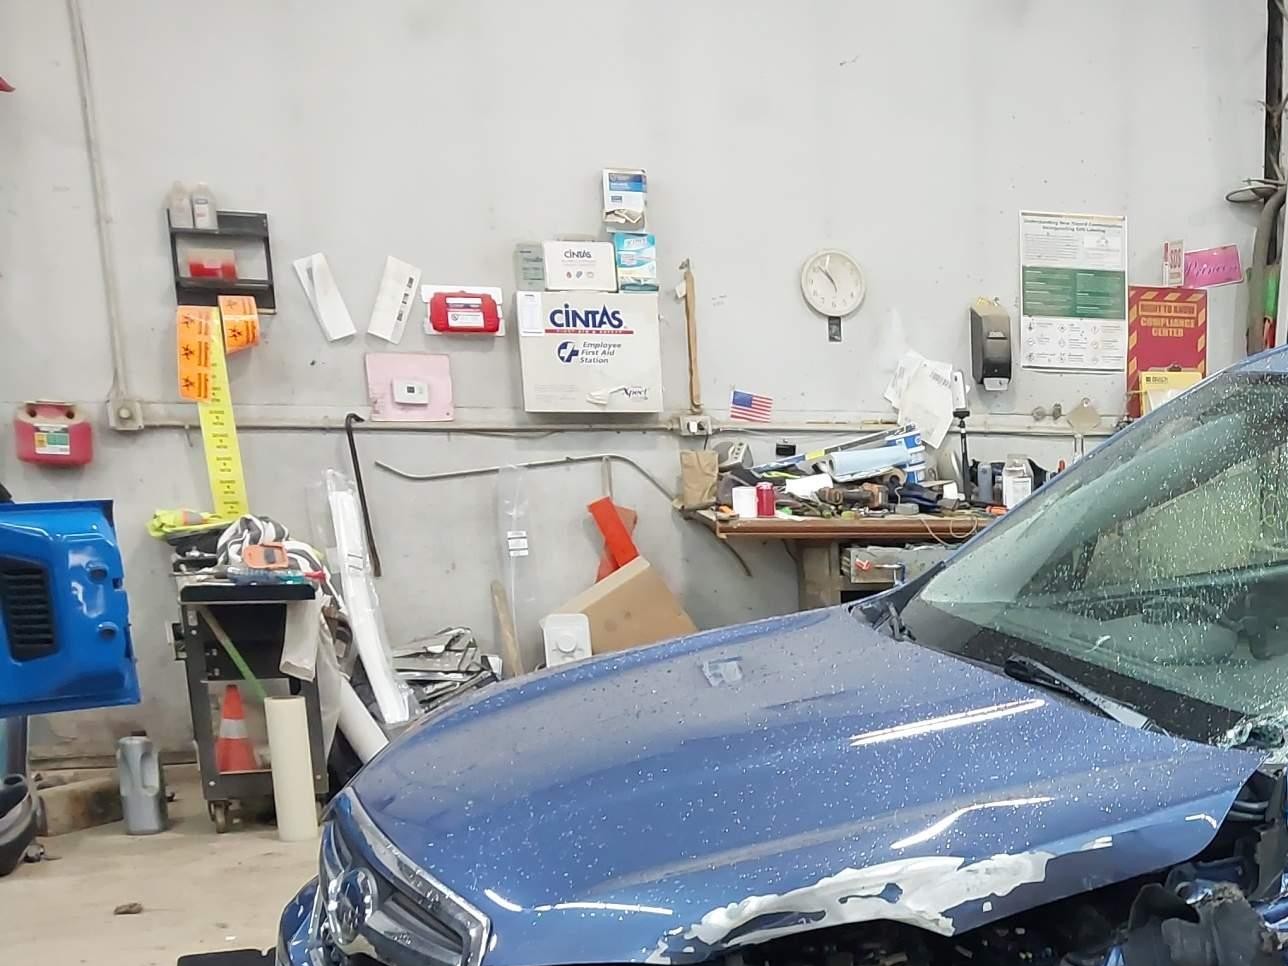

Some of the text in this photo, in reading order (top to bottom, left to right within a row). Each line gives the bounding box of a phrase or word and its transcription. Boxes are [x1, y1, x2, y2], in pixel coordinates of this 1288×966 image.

[549, 303, 623, 329] CINTAS
[1140, 317, 1196, 329] COMPLIANCE
[1152, 328, 1184, 337] CENTER
